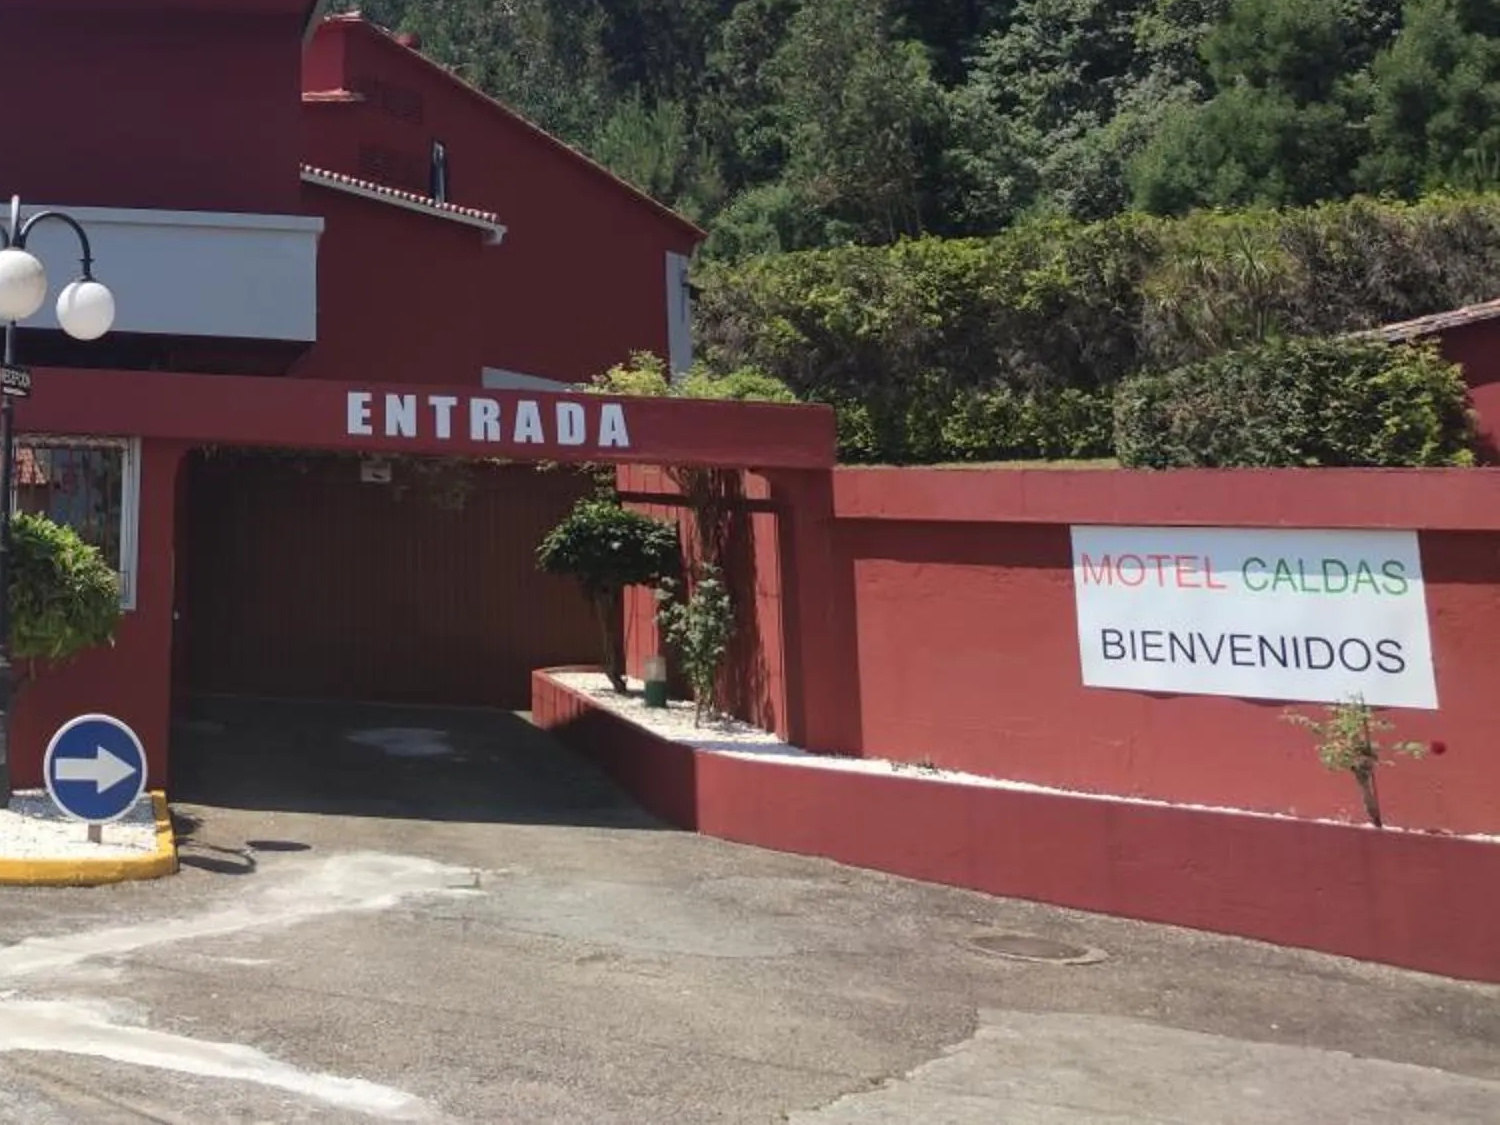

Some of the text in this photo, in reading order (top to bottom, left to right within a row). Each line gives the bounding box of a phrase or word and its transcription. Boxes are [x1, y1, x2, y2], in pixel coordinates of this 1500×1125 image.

[347, 391, 630, 448] ENTRADA
[1080, 552, 1409, 596] MOTEL CALDAS
[1101, 628, 1406, 675] BIENVENIDOS
